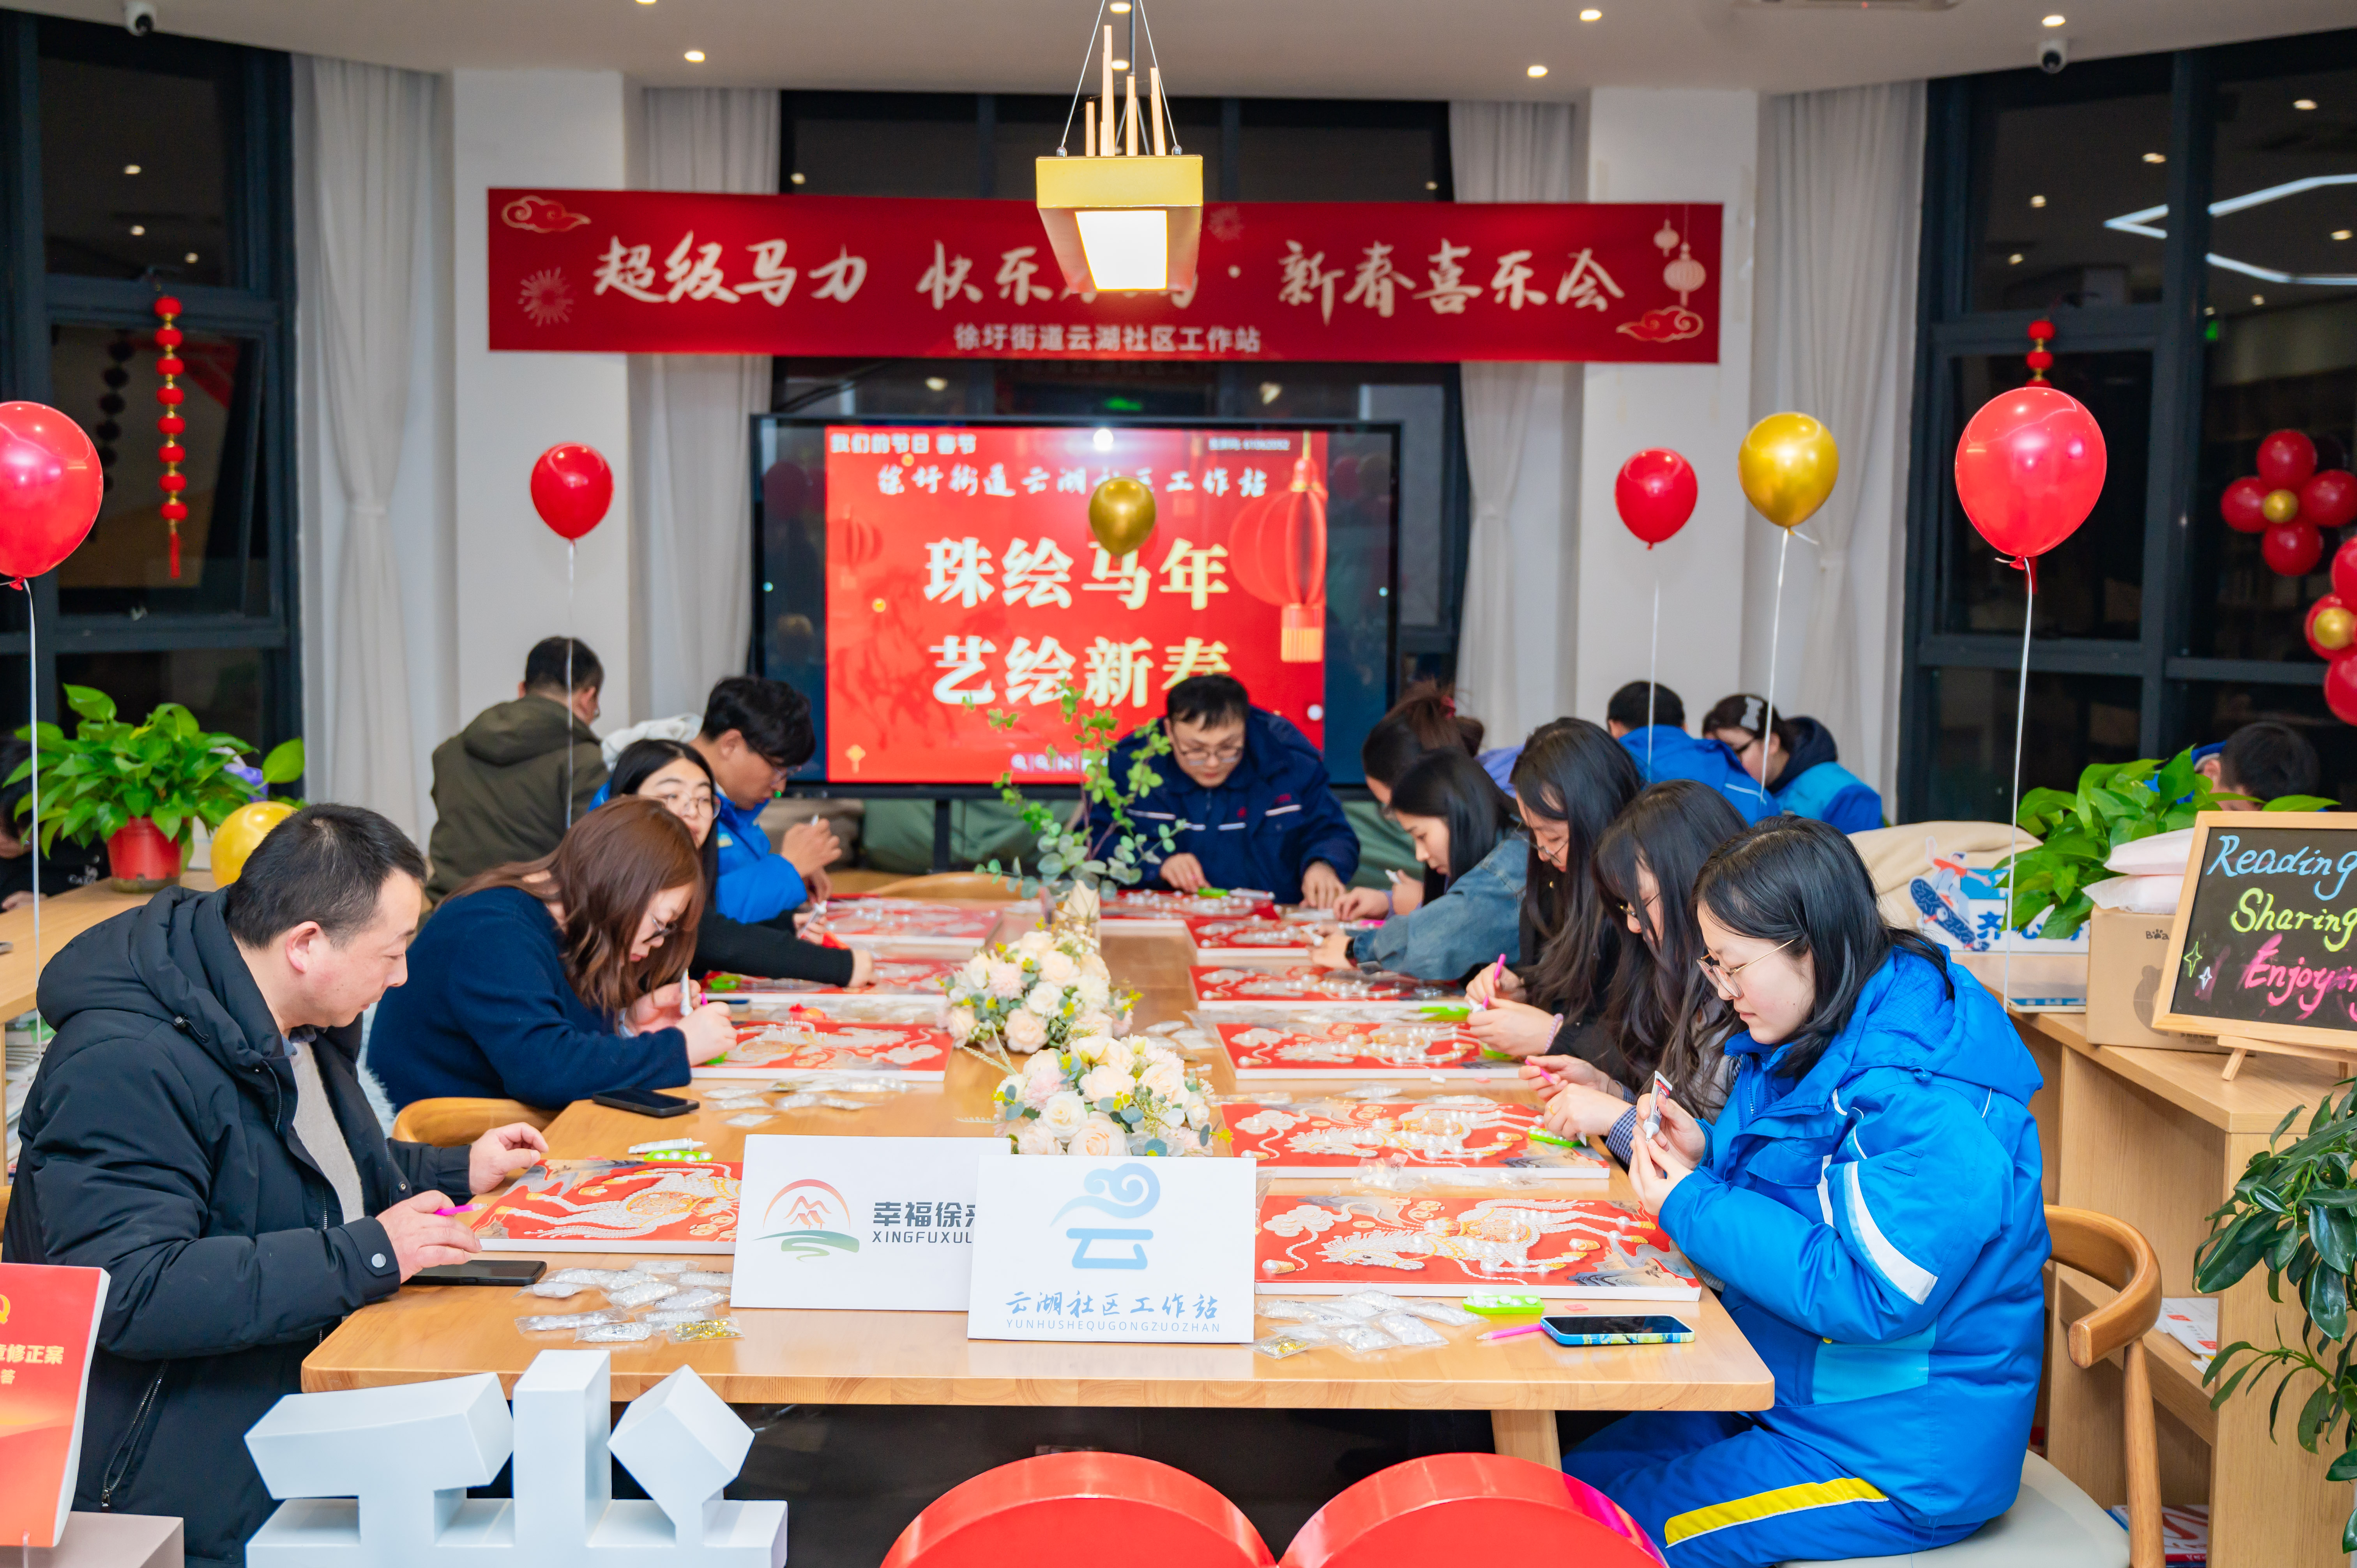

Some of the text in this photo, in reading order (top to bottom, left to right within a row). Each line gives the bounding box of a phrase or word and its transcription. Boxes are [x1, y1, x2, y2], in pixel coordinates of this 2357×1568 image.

[594, 231, 867, 306] 超级马力
[954, 322, 1261, 353] 徐圩街道云湖社区工作站
[924, 537, 1229, 610] 珠绘马年
[2206, 835, 2357, 901] Reading
[2230, 887, 2357, 952] Sharing
[1005, 1290, 1218, 1319] 云湖社区工作站
[1007, 1319, 1220, 1332] YUNHUSHEQUGONGZUOZHAN
